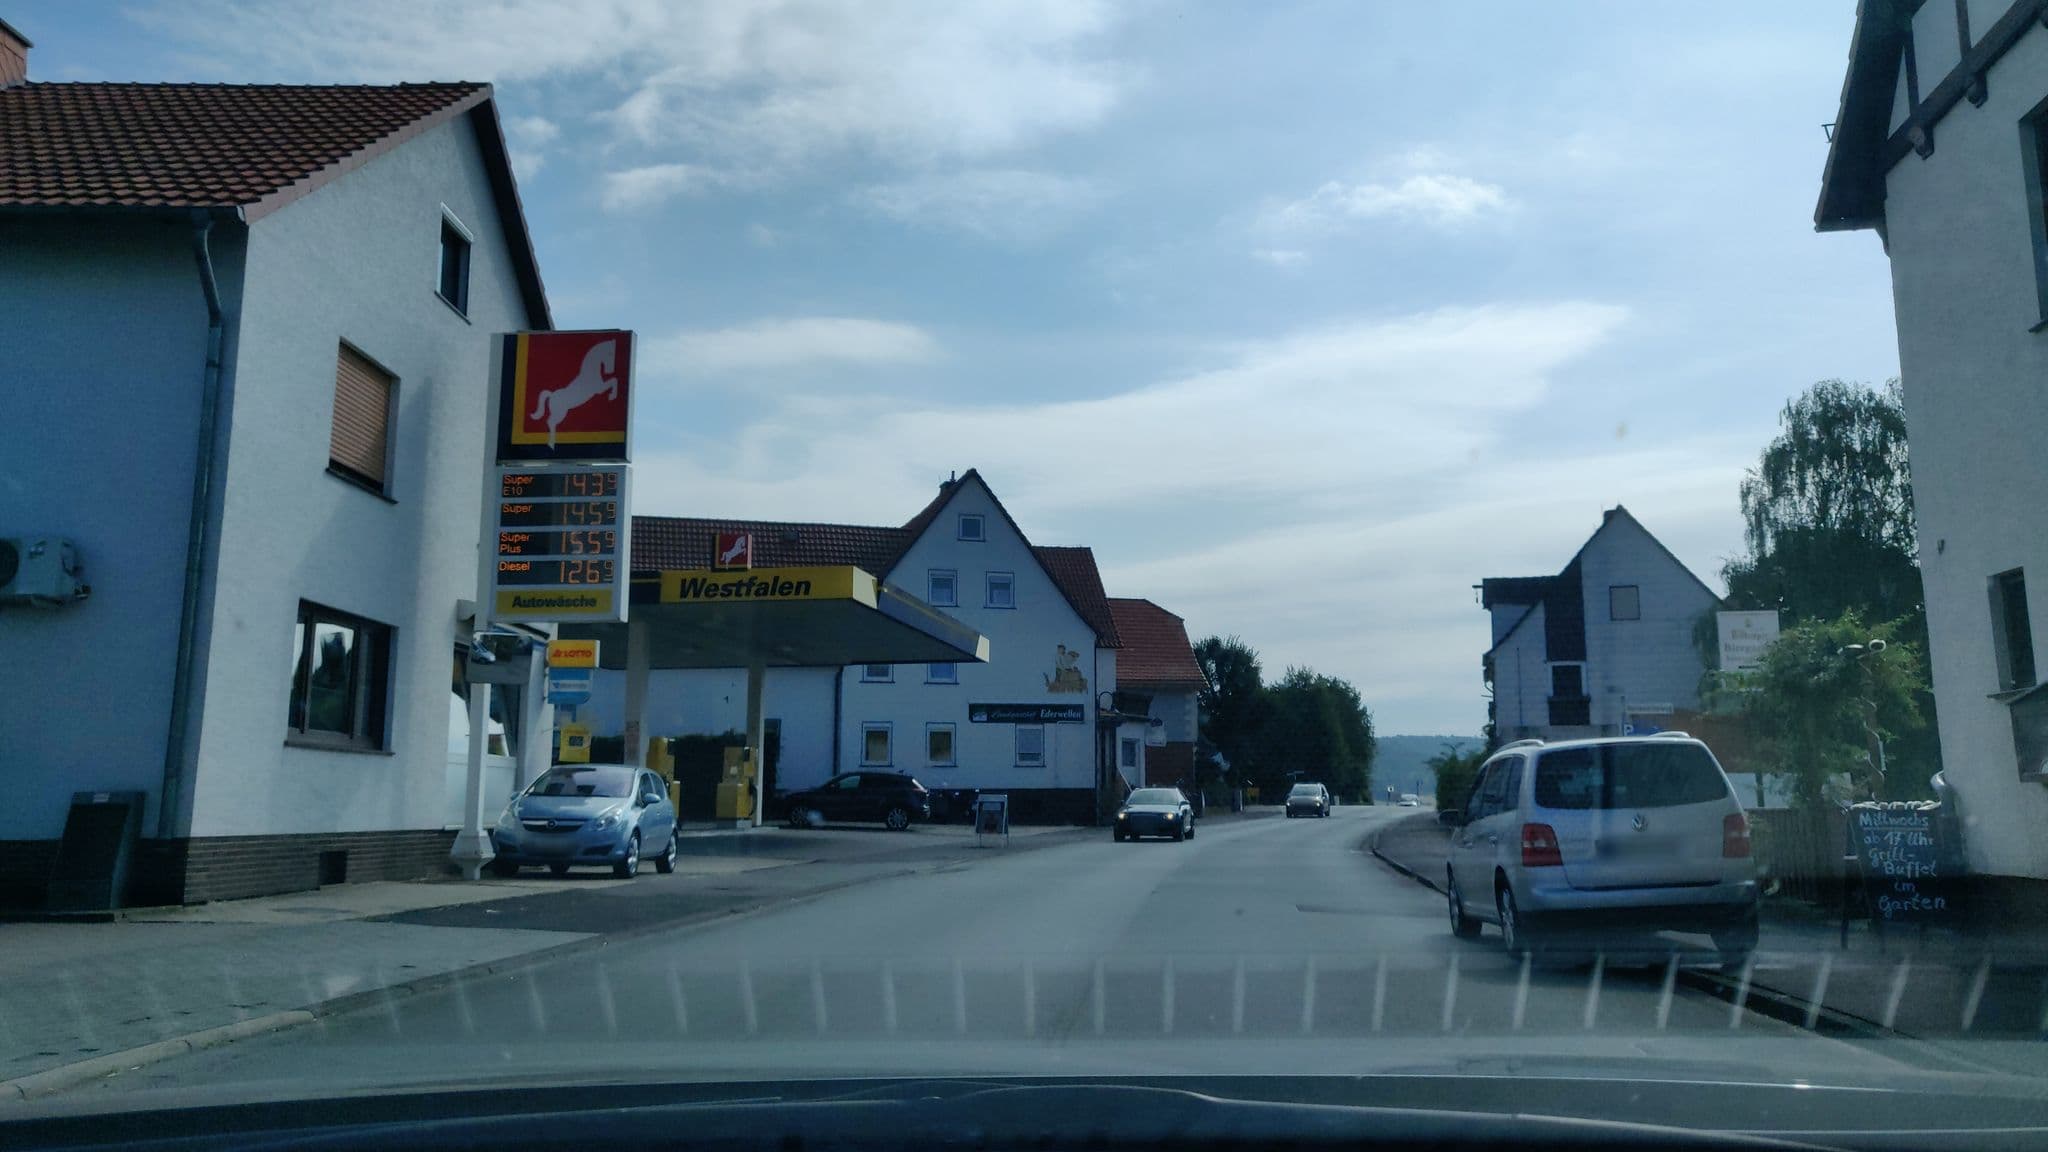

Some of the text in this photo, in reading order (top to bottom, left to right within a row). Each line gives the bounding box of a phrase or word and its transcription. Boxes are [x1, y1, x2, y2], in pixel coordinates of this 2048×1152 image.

[503, 475, 533, 486] Super
[503, 486, 523, 496] E10
[502, 503, 532, 514] Super
[500, 532, 530, 543] Super
[500, 543, 522, 553] Plus
[498, 561, 531, 571] Diesel
[679, 575, 811, 599] Westfalen
[512, 594, 597, 609] Autowäsche
[1860, 812, 1929, 827] Mittwochs
[1863, 831, 1881, 845] ab
[1907, 831, 1934, 846] Uhr
[1883, 860, 1937, 879] Buffet
[1878, 893, 1946, 918] Garten
